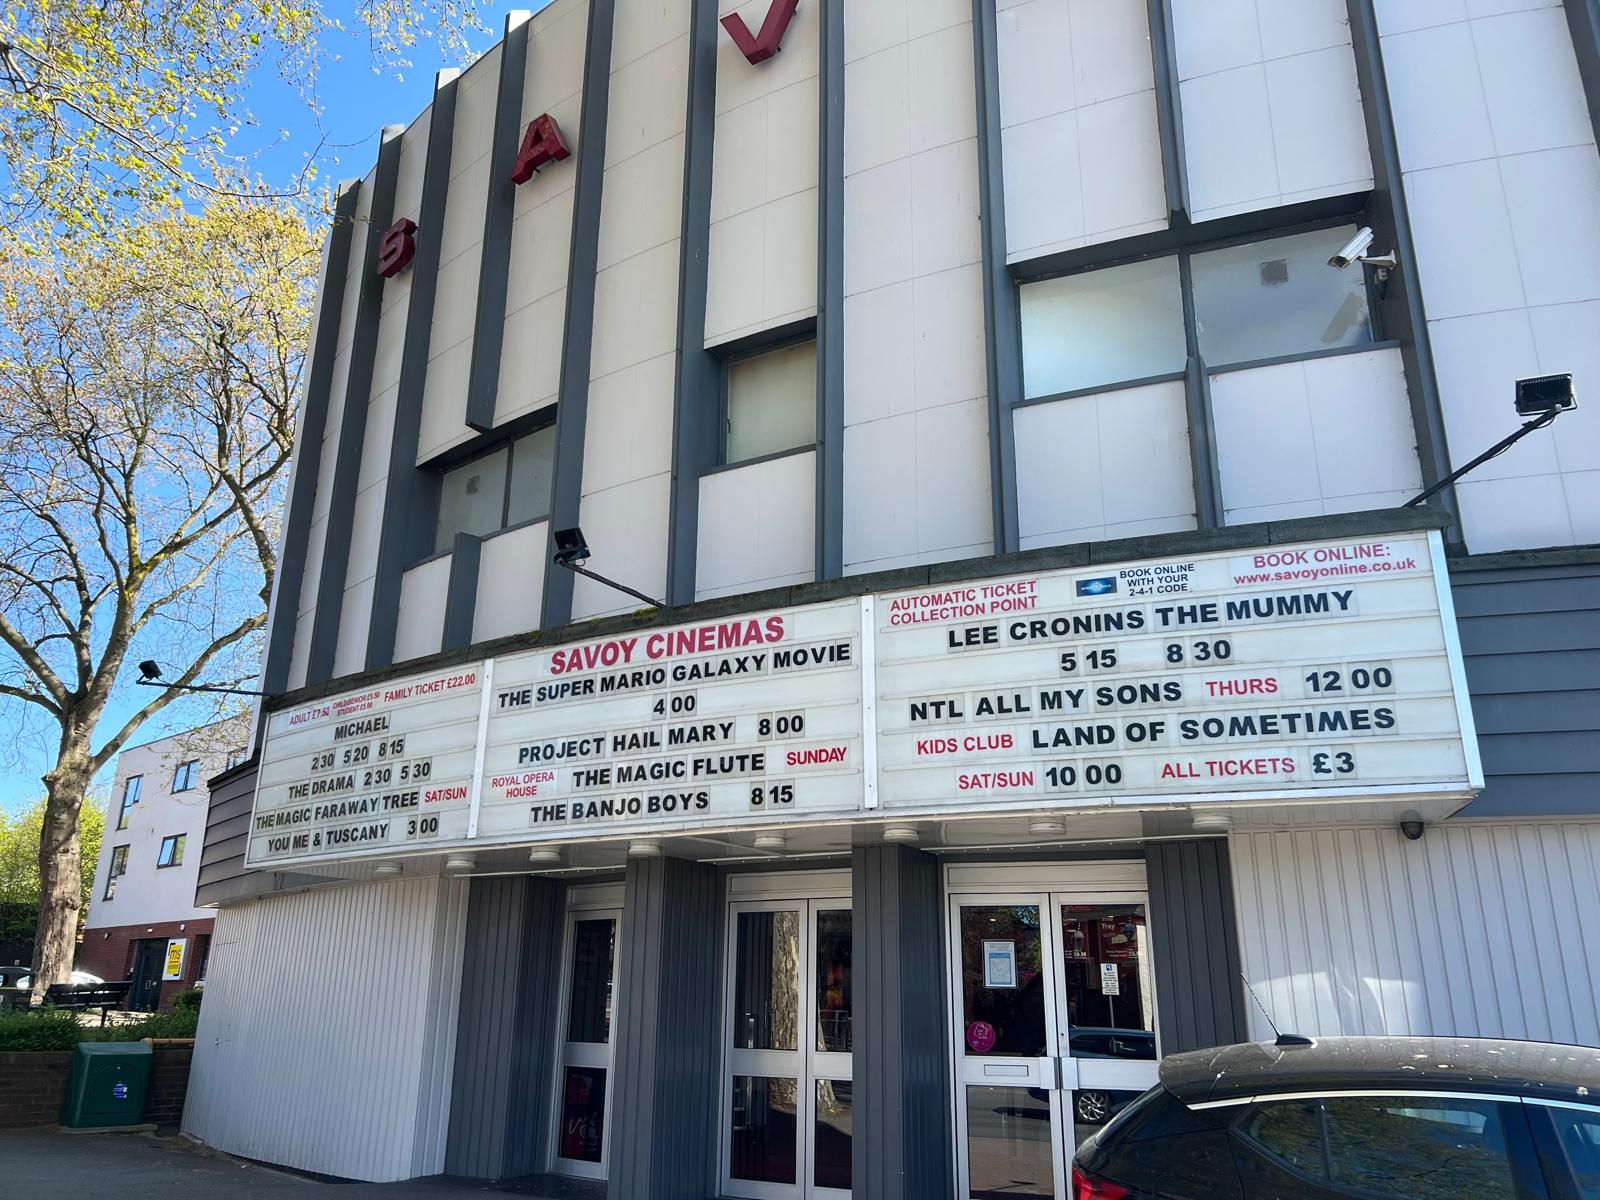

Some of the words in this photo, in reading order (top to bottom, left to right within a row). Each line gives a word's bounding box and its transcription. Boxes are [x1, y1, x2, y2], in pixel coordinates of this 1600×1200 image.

[1253, 547, 1309, 569] BOOK
[1314, 543, 1391, 563] ONLINE:
[1120, 568, 1151, 579] BOOK
[1154, 563, 1195, 575] ONLINE
[1127, 577, 1154, 587] WITH
[1157, 573, 1188, 584] YOUR
[1233, 557, 1416, 585] www.savoyonline.co.uk
[890, 589, 976, 612] AUTOMATIC
[981, 580, 1037, 599] TICKET
[1129, 586, 1153, 597] 2-4-1
[1157, 583, 1188, 594] CODE
[890, 603, 986, 626] COLLECTION
[990, 595, 1038, 612] POINT
[949, 625, 998, 648] LEE
[1009, 610, 1145, 640] CRONINS
[1155, 603, 1219, 626] THE
[1226, 589, 1354, 621] MUMMY
[550, 637, 637, 675] SAVOY
[645, 616, 784, 660] CINEMAS
[384, 686, 413, 702] FAMILY
[415, 679, 446, 695] TICKET
[447, 673, 475, 689] £22.00
[499, 689, 531, 708] THE
[536, 679, 594, 702] SUPER
[600, 668, 666, 693] MARIO
[672, 653, 766, 682] GALAXY
[773, 643, 851, 669] MOVIE
[336, 704, 360, 717] STUDENT
[910, 700, 963, 721] NTL
[976, 694, 1030, 716] ALL
[1040, 689, 1084, 710] MY
[1096, 681, 1182, 706] SONS
[1205, 677, 1279, 697] THURS
[290, 711, 311, 726] ADULT
[334, 716, 388, 741] MICHAEL
[917, 738, 958, 755] KIDS
[963, 734, 1013, 752] CLUB
[1032, 724, 1115, 749] LAND
[1125, 722, 1165, 742] OF
[1180, 707, 1395, 740] SOMETIMES
[518, 737, 605, 764] PROJECT
[612, 730, 660, 752] HAIL
[668, 721, 734, 747] MARY
[491, 773, 521, 788] ROYAL
[523, 771, 555, 785] OPERA
[573, 768, 611, 788] THE
[617, 760, 686, 783] MAGIC
[693, 752, 765, 777] FLUTE
[786, 746, 847, 766] SUNDAY
[958, 770, 1034, 790] SAT/SUN
[1161, 760, 1200, 778] ALL
[1205, 757, 1295, 776] TICKETS
[1312, 751, 1354, 773] £3
[288, 783, 309, 800] THE
[311, 775, 354, 795] DRAMA
[506, 785, 538, 798] HOUSE
[256, 814, 275, 830] THE
[275, 808, 311, 827] MAGIC
[314, 797, 379, 821] FARAWAY
[382, 791, 419, 810] TREE
[424, 787, 467, 803] SAT/SUN
[531, 803, 566, 823] THE
[572, 796, 642, 820] BANJO
[647, 791, 709, 813] BOYS
[268, 836, 289, 852] YOU
[293, 834, 308, 849] ME
[312, 832, 321, 847] &
[326, 823, 388, 845] TUSCANY
